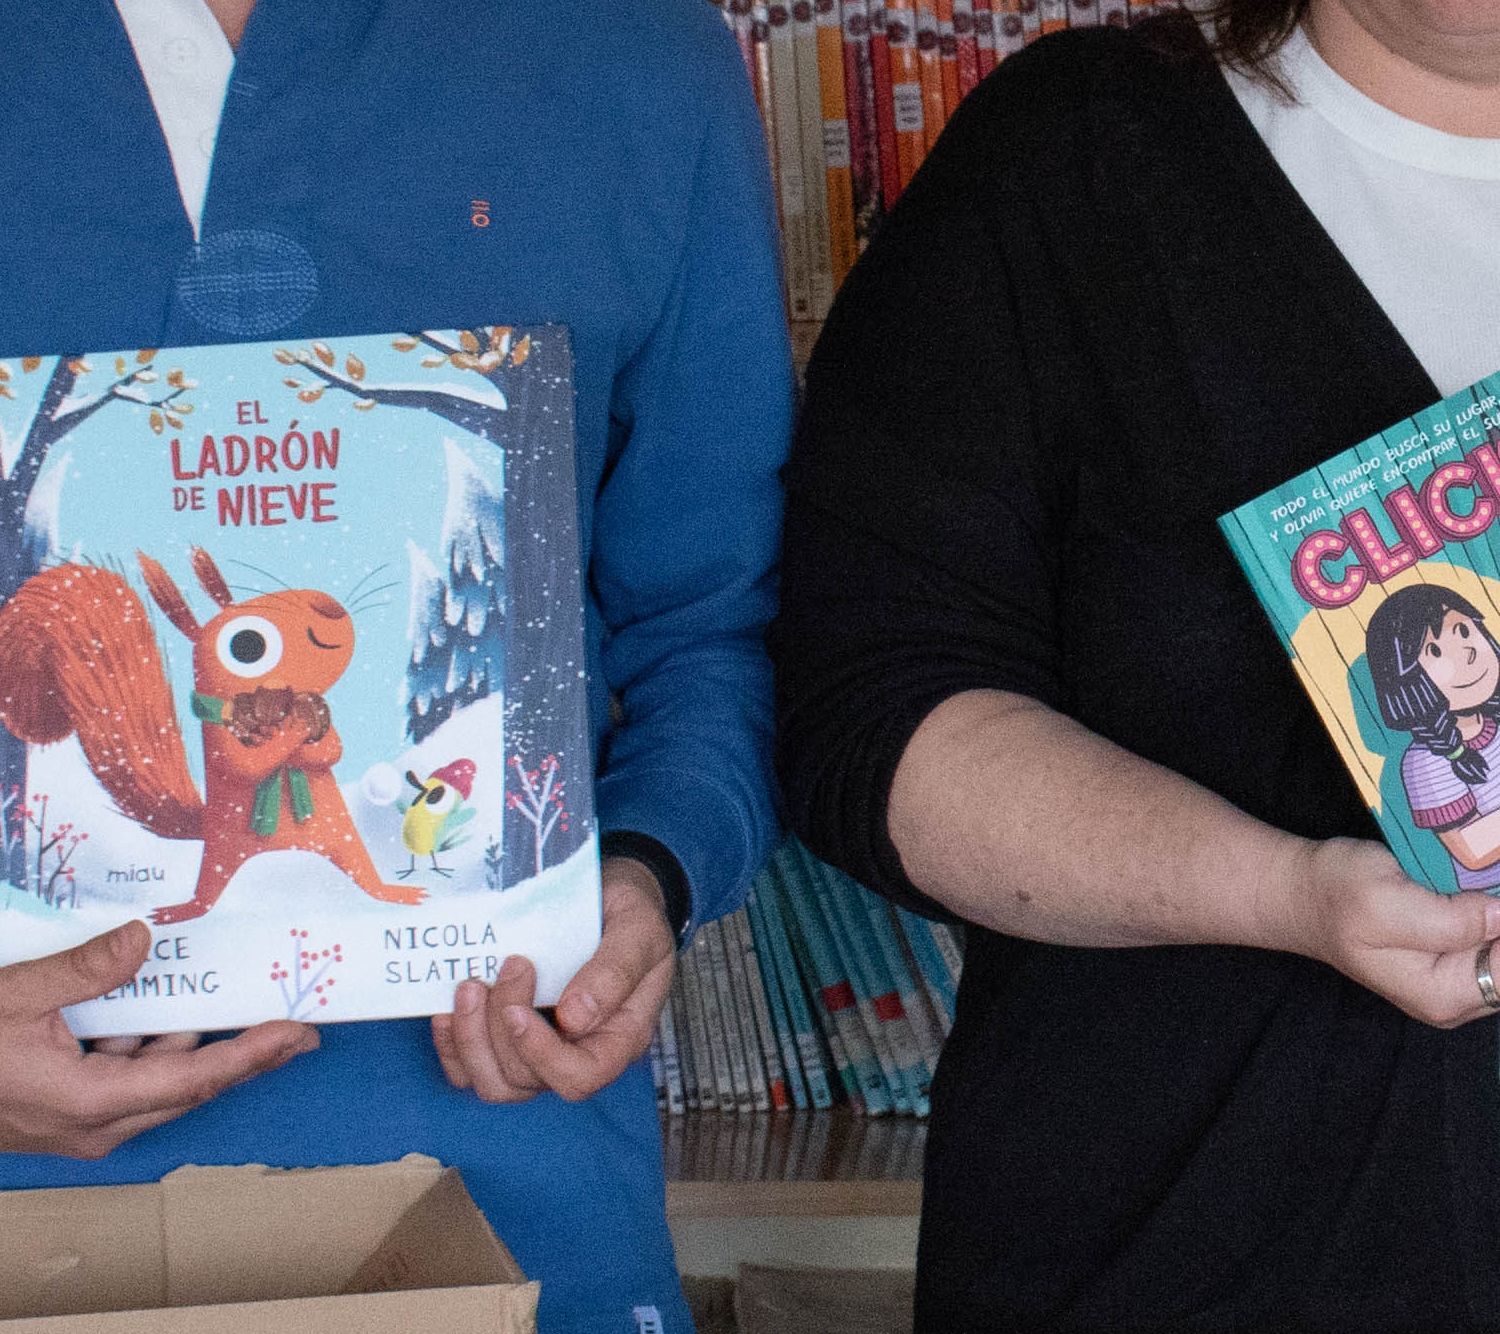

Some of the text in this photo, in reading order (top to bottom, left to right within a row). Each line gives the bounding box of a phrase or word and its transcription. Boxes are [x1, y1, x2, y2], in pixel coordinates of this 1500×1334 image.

[236, 400, 269, 426] EL
[169, 420, 340, 482] LADRÓN
[1312, 418, 1452, 500] EL MUNDO BUSCA SU
[1283, 505, 1326, 535] OLIVIA
[1328, 480, 1377, 512] QUIERE
[1382, 436, 1458, 483] ENCONTRAR
[1461, 427, 1480, 442] EL
[172, 481, 339, 527] DE NIEVE
[106, 865, 165, 884] miau
[384, 922, 498, 950] NICOLA
[386, 954, 498, 984] SLATER
